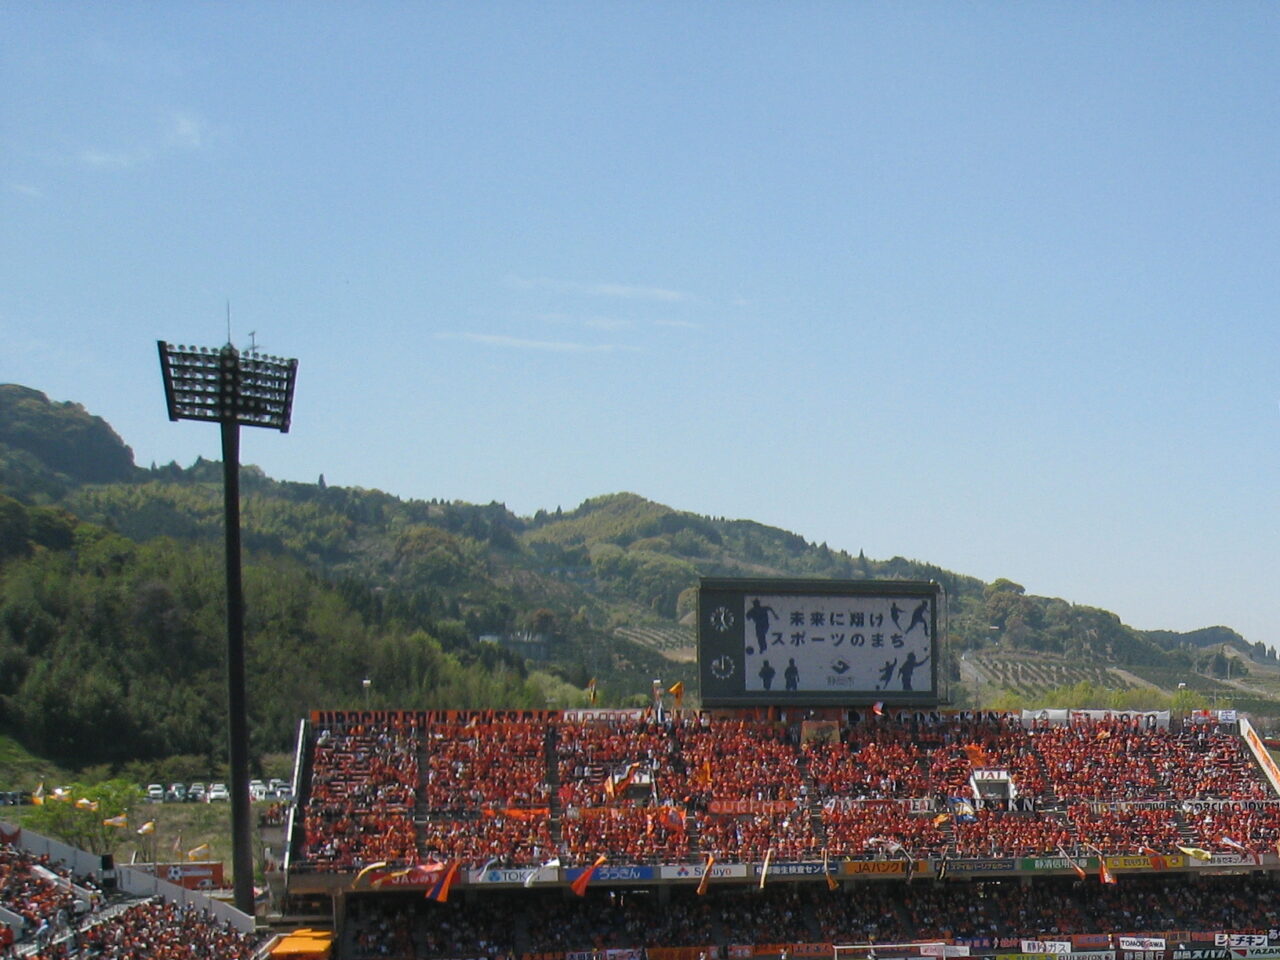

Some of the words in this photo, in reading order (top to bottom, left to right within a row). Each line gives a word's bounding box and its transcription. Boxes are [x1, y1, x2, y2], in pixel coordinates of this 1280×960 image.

[789, 611, 884, 627] 未来に翔け
[771, 632, 905, 648] スポーツのまち
[600, 867, 641, 880] ろうきん
